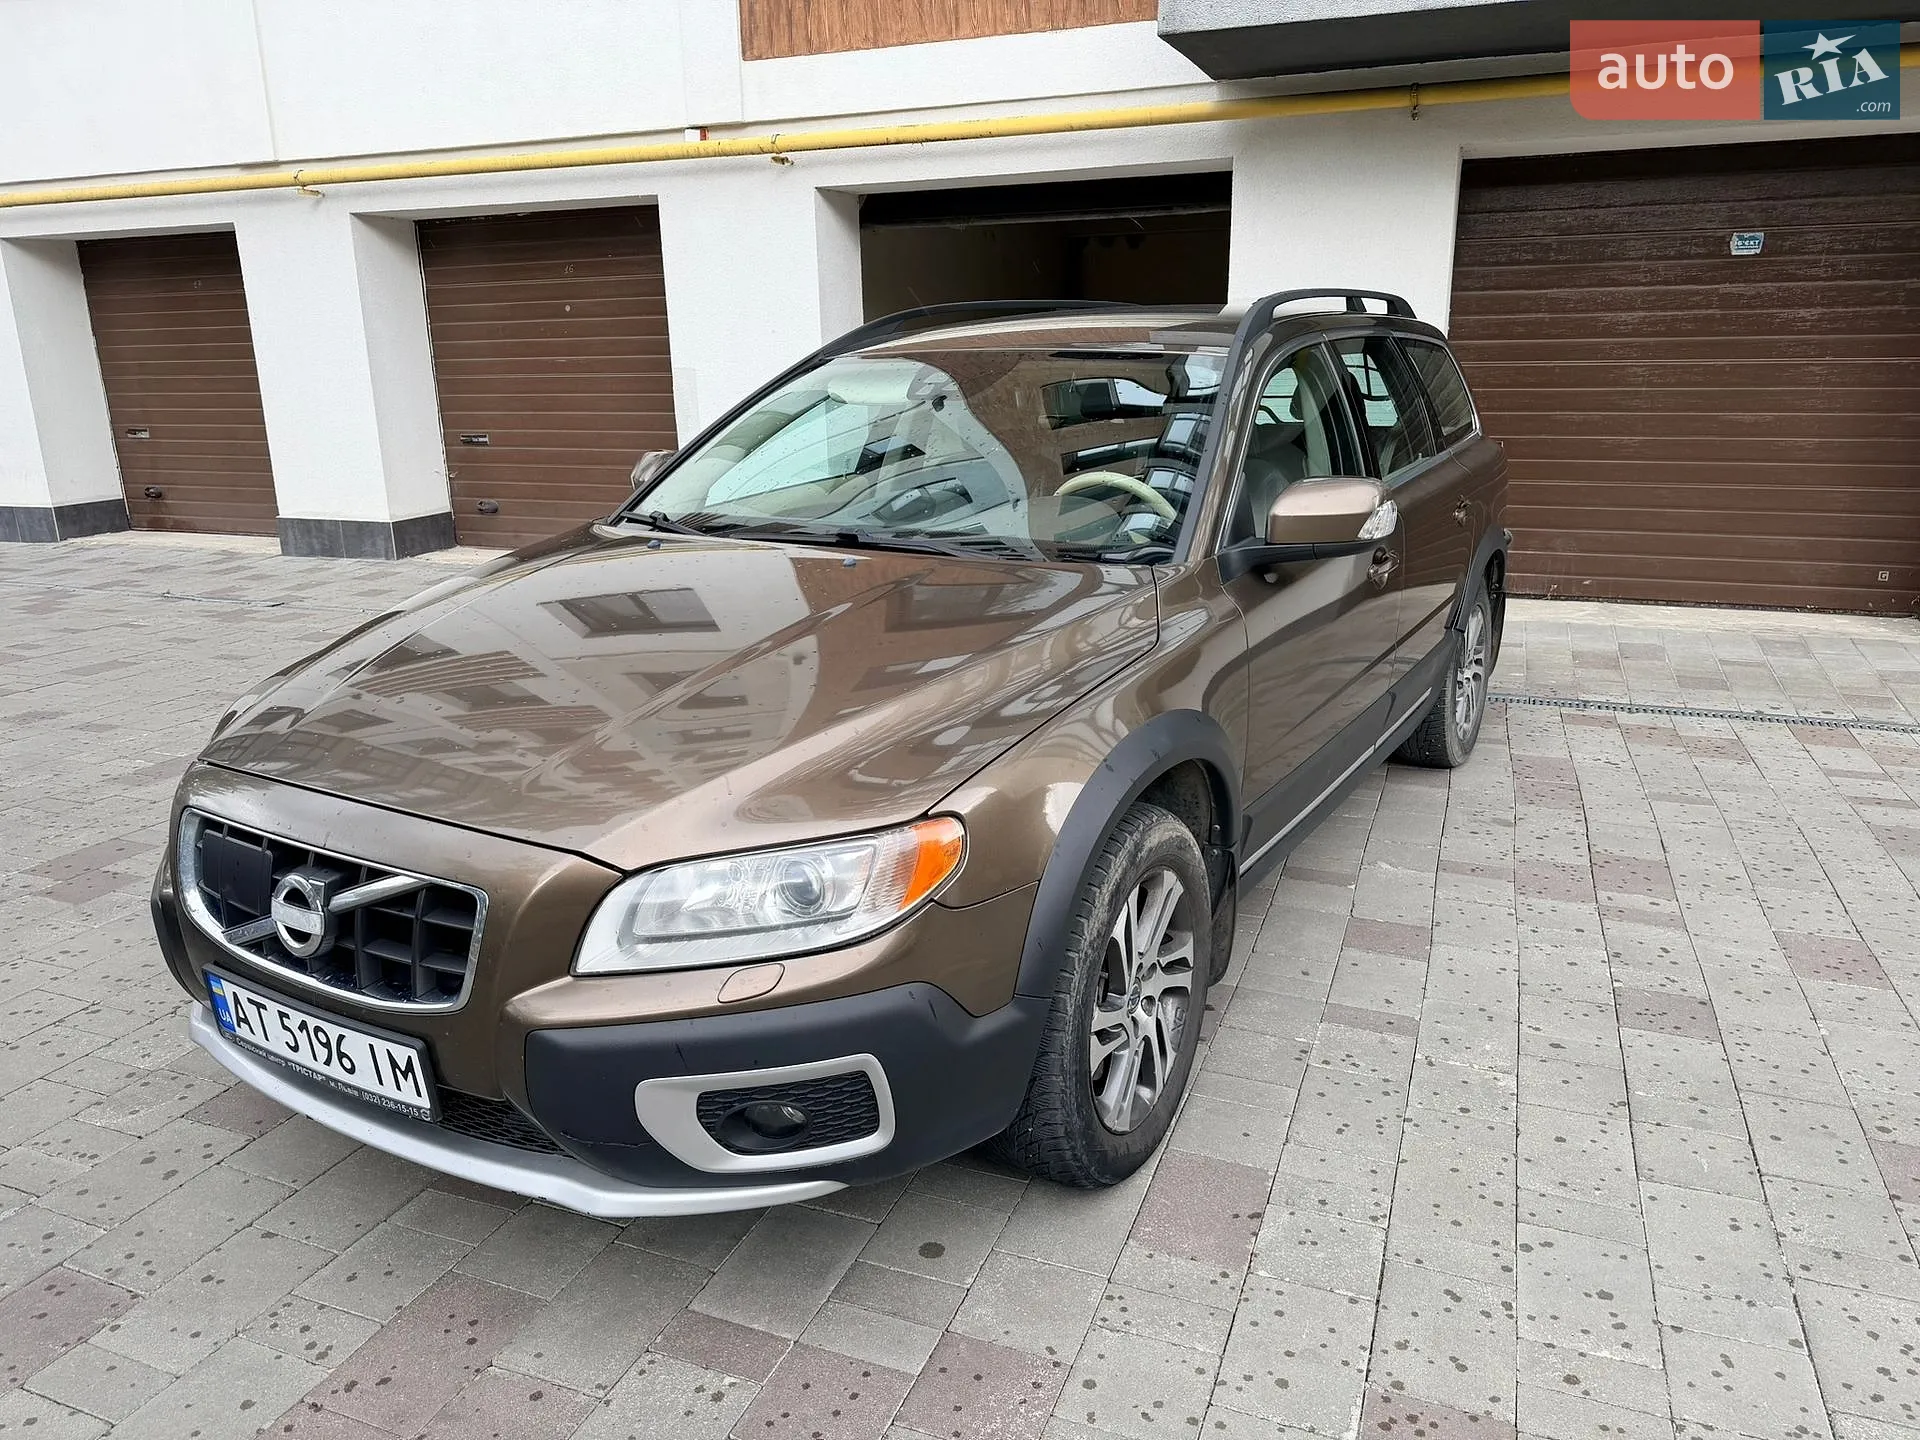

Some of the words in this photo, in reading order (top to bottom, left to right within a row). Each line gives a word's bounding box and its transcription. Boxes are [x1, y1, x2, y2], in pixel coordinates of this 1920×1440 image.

[218, 1008, 233, 1025] UA
[232, 991, 270, 1042] AT
[277, 1009, 356, 1075] 5196
[368, 1043, 422, 1098] IM
[361, 1091, 380, 1105] (032)
[381, 1098, 419, 1117] 236-15-15
